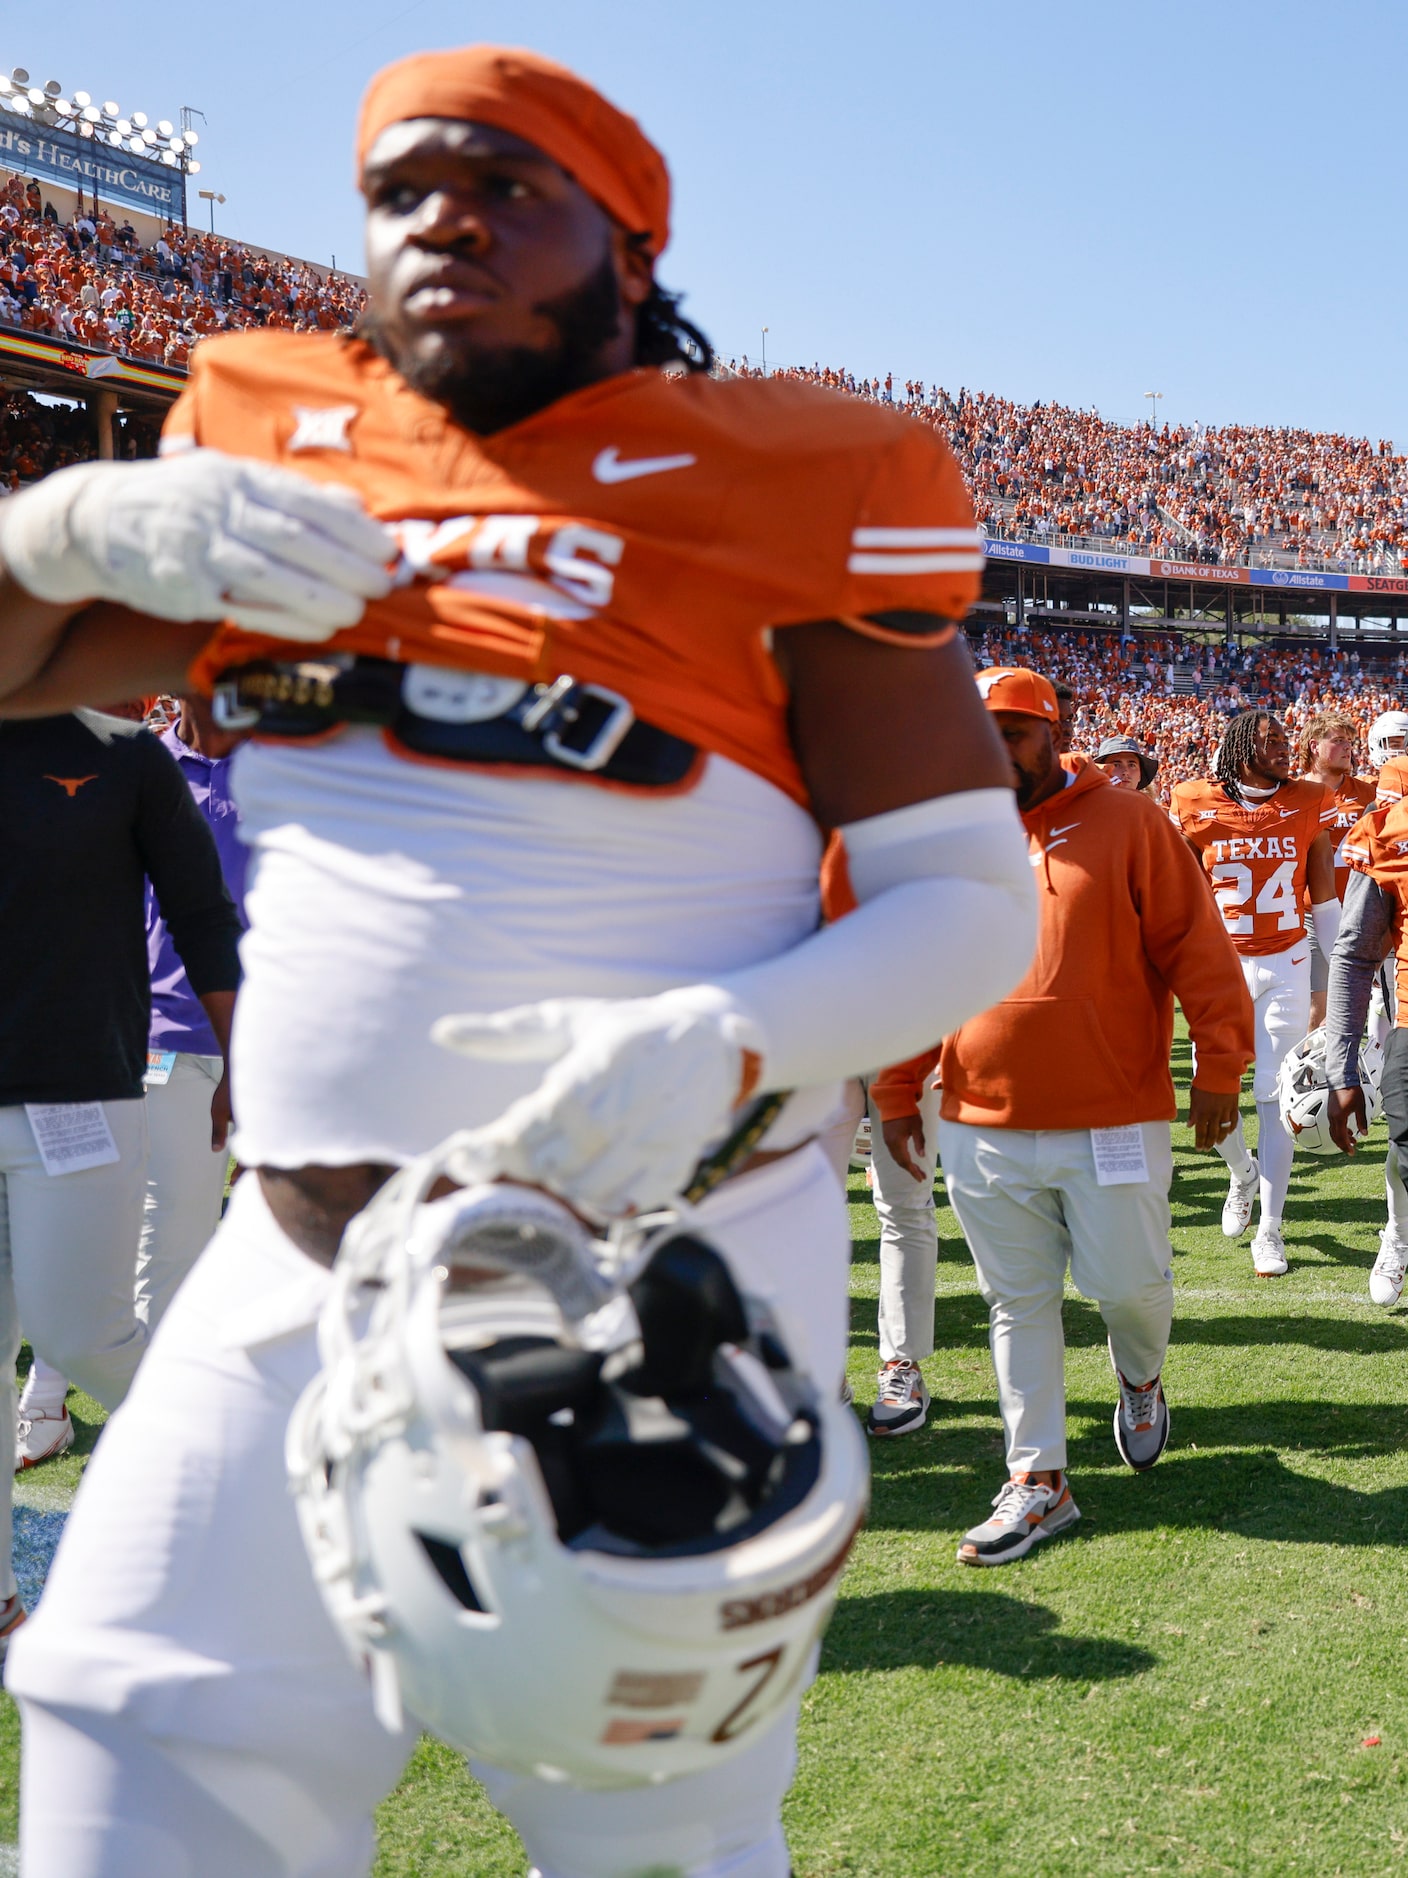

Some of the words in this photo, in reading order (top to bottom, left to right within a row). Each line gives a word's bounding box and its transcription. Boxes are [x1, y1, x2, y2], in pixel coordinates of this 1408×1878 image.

[988, 543, 1025, 559] Allstate
[1070, 554, 1094, 566] BUD
[1095, 556, 1128, 569] LIGHT
[1172, 566, 1198, 577] BANK
[1198, 567, 1210, 577] OF
[1211, 568, 1240, 580] TEXAS
[1288, 574, 1325, 586] Allstate
[1334, 812, 1359, 828] AS
[1211, 836, 1298, 862] TEXAS
[1211, 860, 1301, 935] 24
